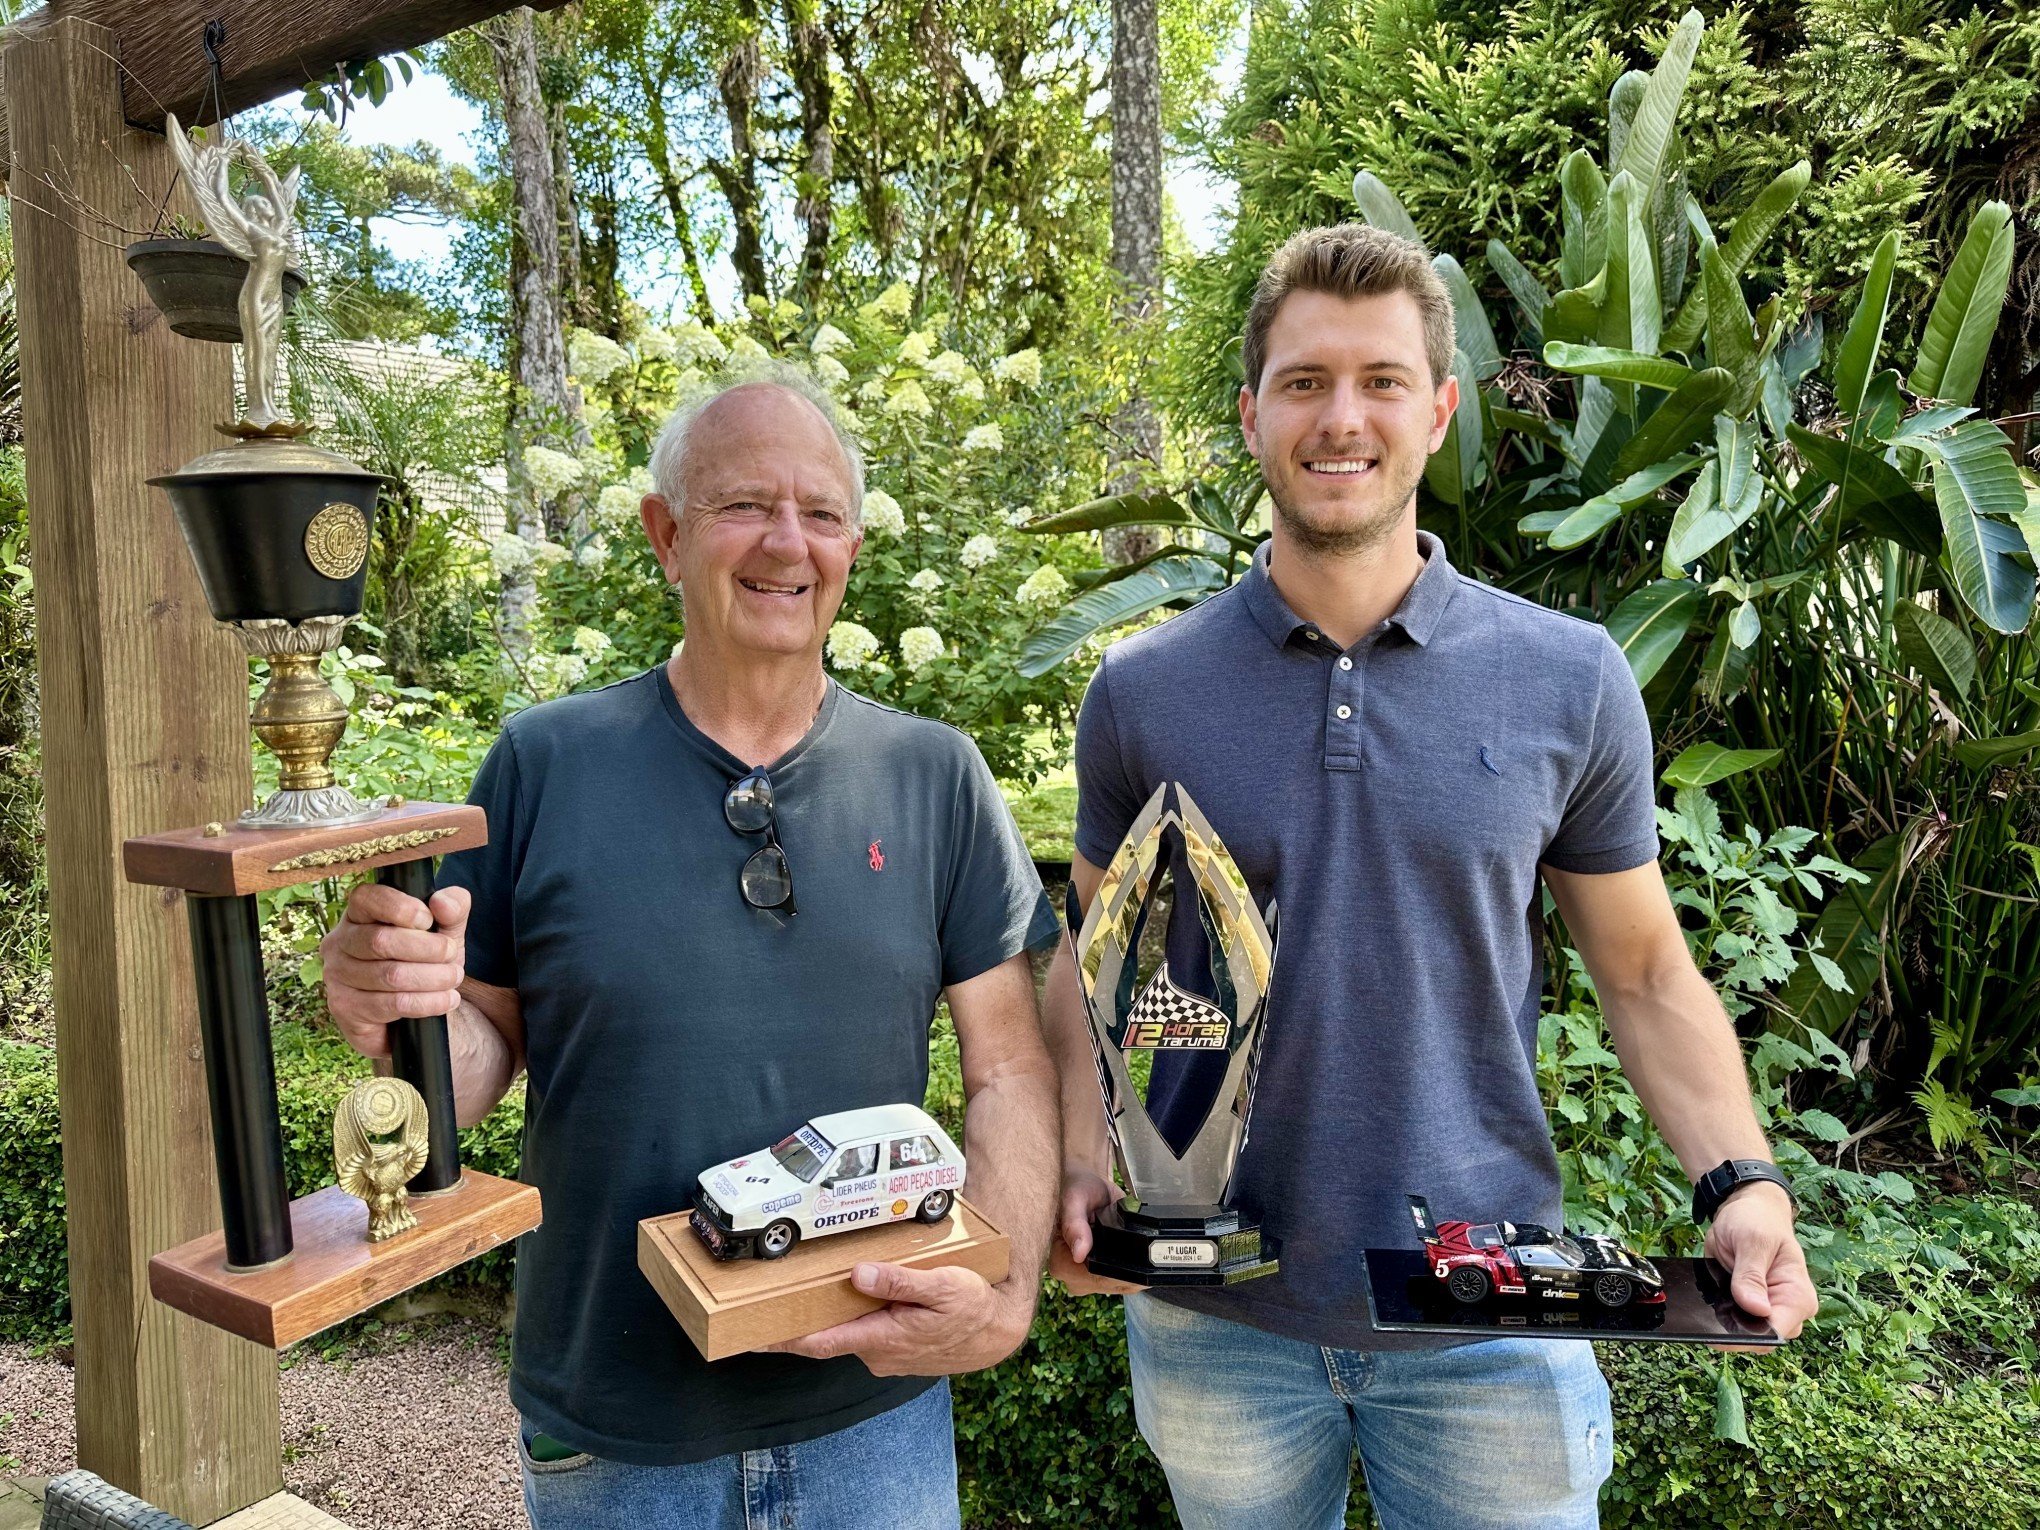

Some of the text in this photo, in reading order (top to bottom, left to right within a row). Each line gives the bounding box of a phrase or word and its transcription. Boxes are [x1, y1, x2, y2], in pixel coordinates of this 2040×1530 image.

[1124, 1023, 1164, 1047] 12
[800, 1130, 830, 1157] ORTOPÉ
[900, 1142, 924, 1162] 64
[745, 1175, 771, 1185] 64
[854, 1179, 877, 1194] PNEUS
[889, 1165, 959, 1195] AGRO PEÇAS DIESEL
[761, 1193, 802, 1214] copeme
[814, 1203, 880, 1229] ORTOPÉ
[1176, 1246, 1197, 1255] LUGAR
[1435, 1259, 1450, 1278] 5
[1542, 1289, 1565, 1299] dnk
